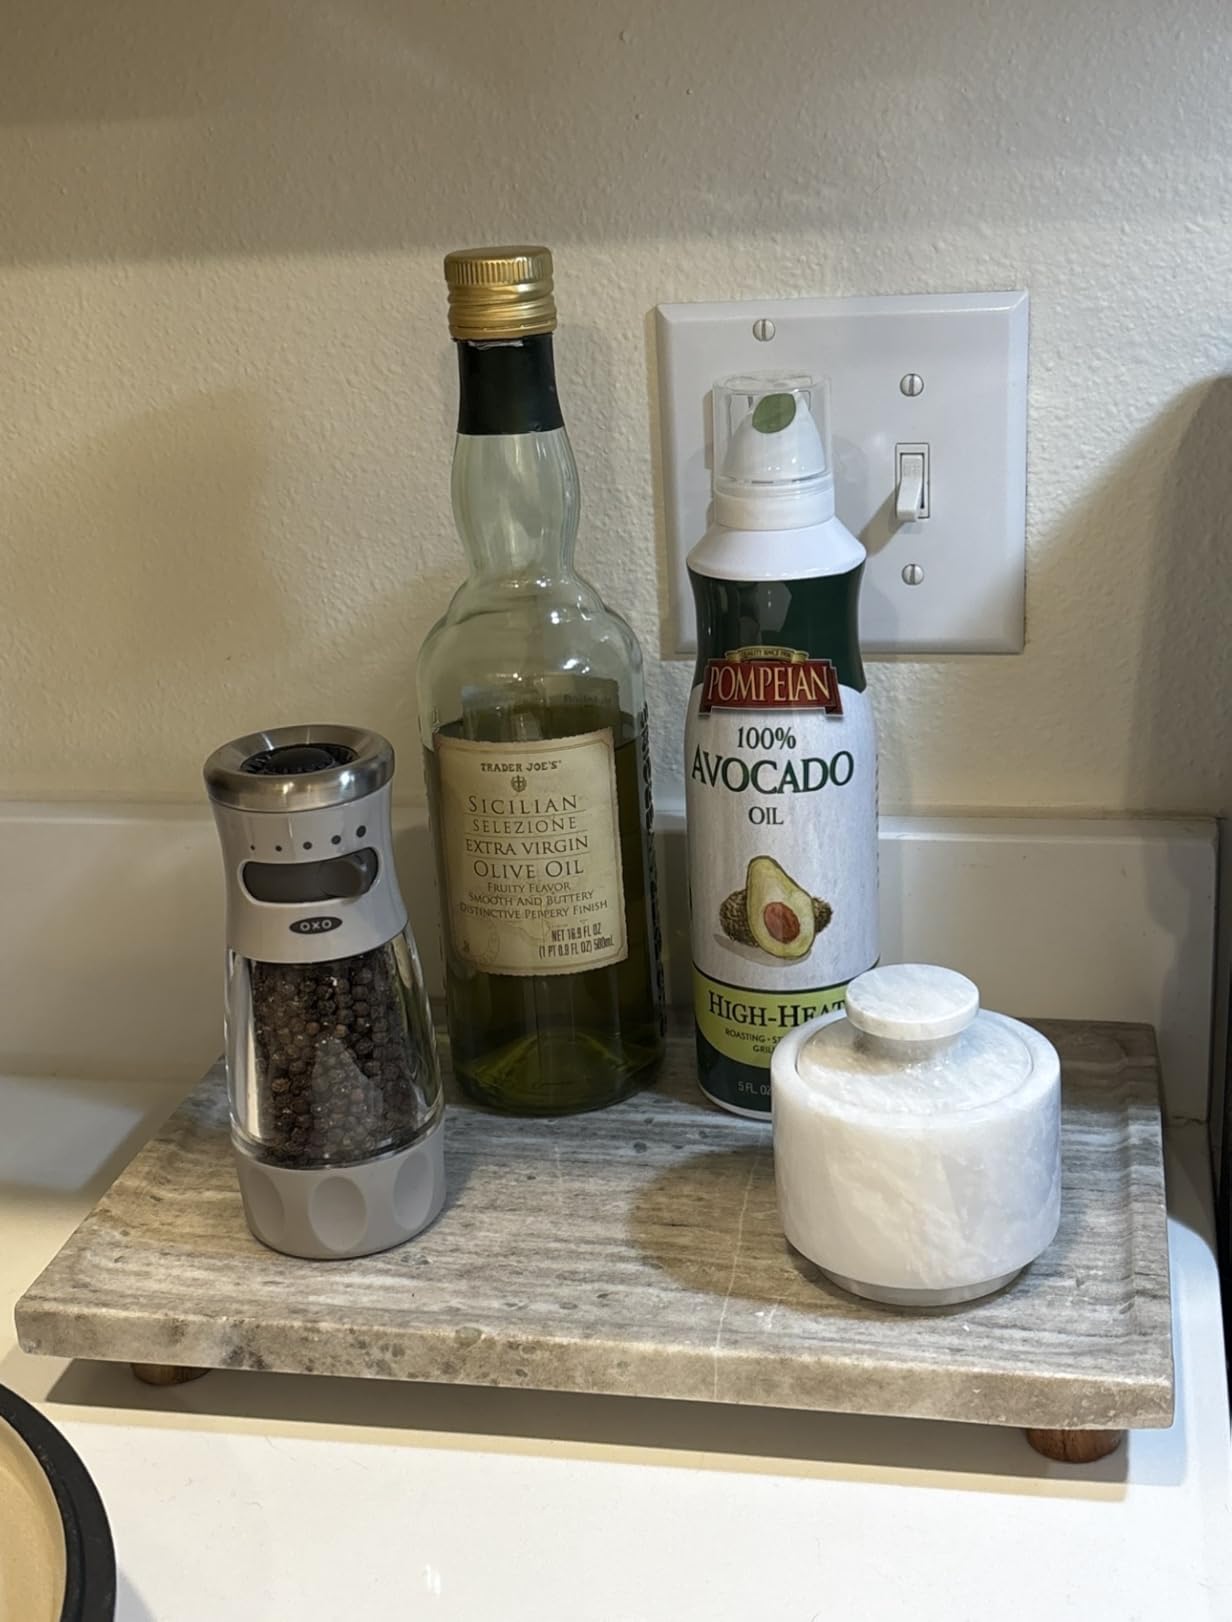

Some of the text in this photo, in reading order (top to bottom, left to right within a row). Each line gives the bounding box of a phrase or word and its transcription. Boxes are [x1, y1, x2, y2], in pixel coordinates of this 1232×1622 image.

[708, 665, 831, 701] POMPEIAN
[737, 726, 797, 750] 100%
[480, 760, 560, 773] TRADER JOE'S
[691, 743, 855, 795] AVOCADO
[468, 794, 577, 815] SICILIAN
[472, 816, 577, 834] SELEZIONE
[748, 806, 785, 826] OIL
[465, 835, 589, 856] EXTRA VIRGIN
[473, 859, 585, 879] OLIVE OIL
[487, 881, 571, 893] FRUITY FLAVOR
[468, 889, 594, 907] SMOOTH AND BUTTERY
[459, 899, 608, 920] DISTINCTIVE PEPPERY FINISH
[299, 919, 333, 931] OXO
[551, 928, 565, 942] NET
[583, 924, 591, 938] FL
[592, 922, 602, 936] OZ
[548, 945, 556, 957] PT
[571, 942, 579, 955] FL
[724, 1027, 766, 1043] ROASTING
[737, 1080, 745, 1092] 5
[745, 1081, 759, 1095] FL
